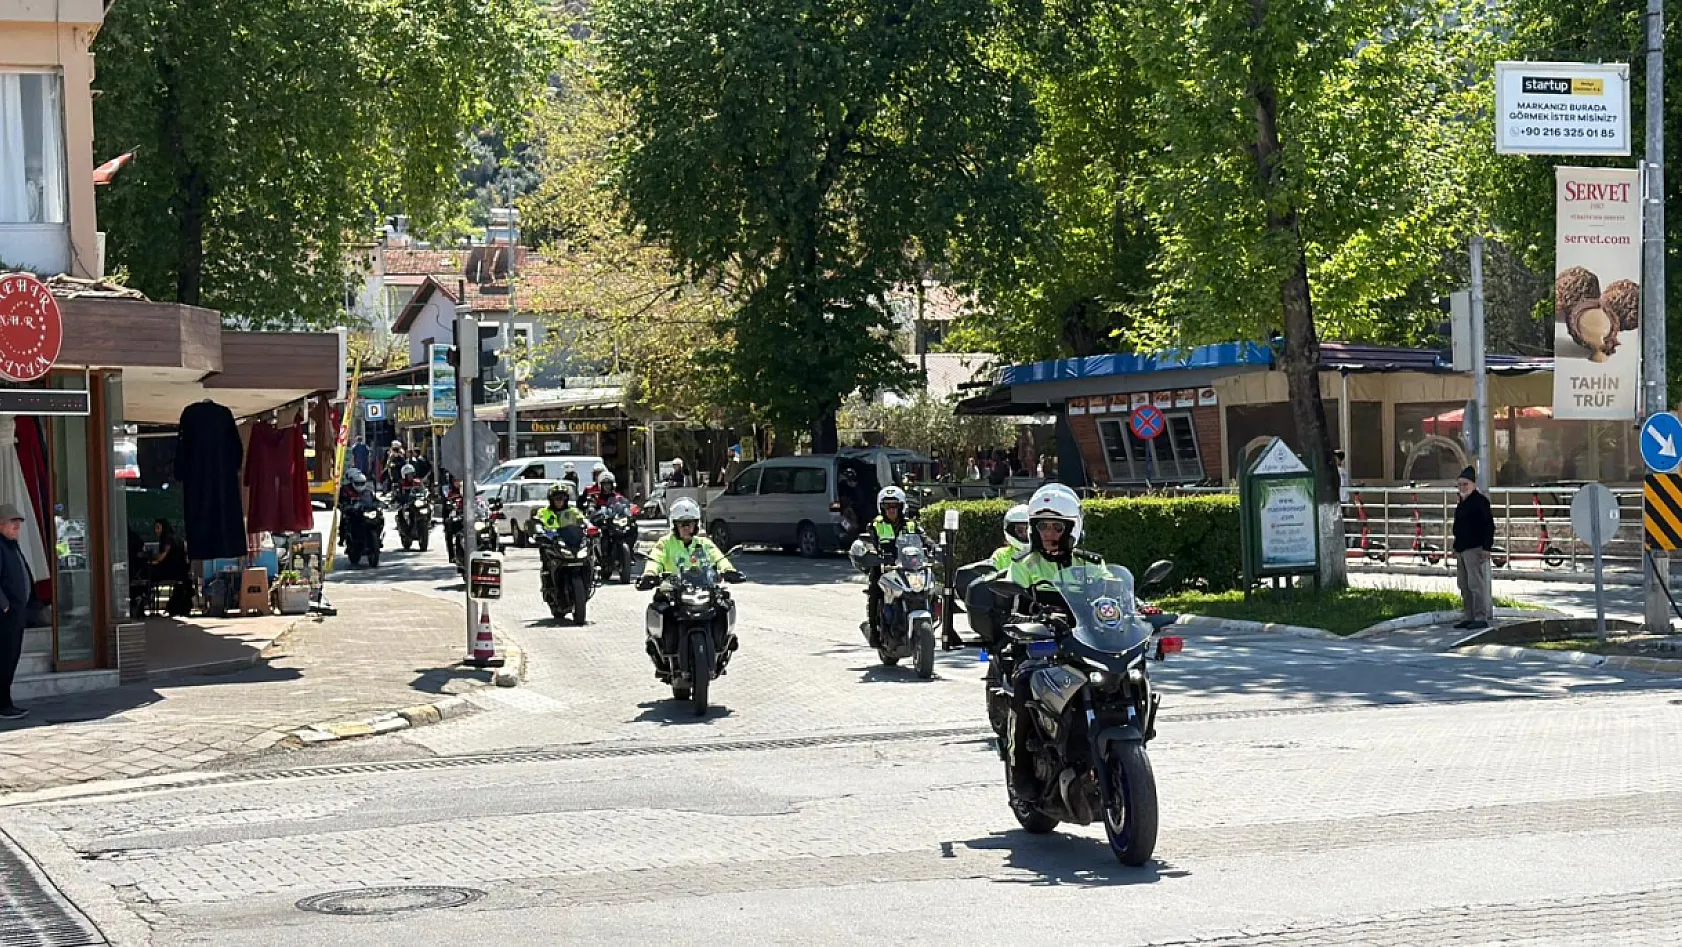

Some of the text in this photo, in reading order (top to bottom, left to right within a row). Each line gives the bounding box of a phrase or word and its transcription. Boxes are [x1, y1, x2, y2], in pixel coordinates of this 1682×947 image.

[1525, 79, 1569, 93] startup
[1517, 102, 1568, 111] MARKANIZI
[1509, 111, 1618, 123] GÖRMEK İSTER MİSİNİZ?
[1521, 126, 1616, 138] +90 216 325 01 85
[1564, 180, 1631, 203] SERVET
[1564, 233, 1631, 244] servet.com
[1570, 373, 1620, 389] TAHİN
[1573, 391, 1616, 407] TRÜF
[371, 406, 378, 416] D
